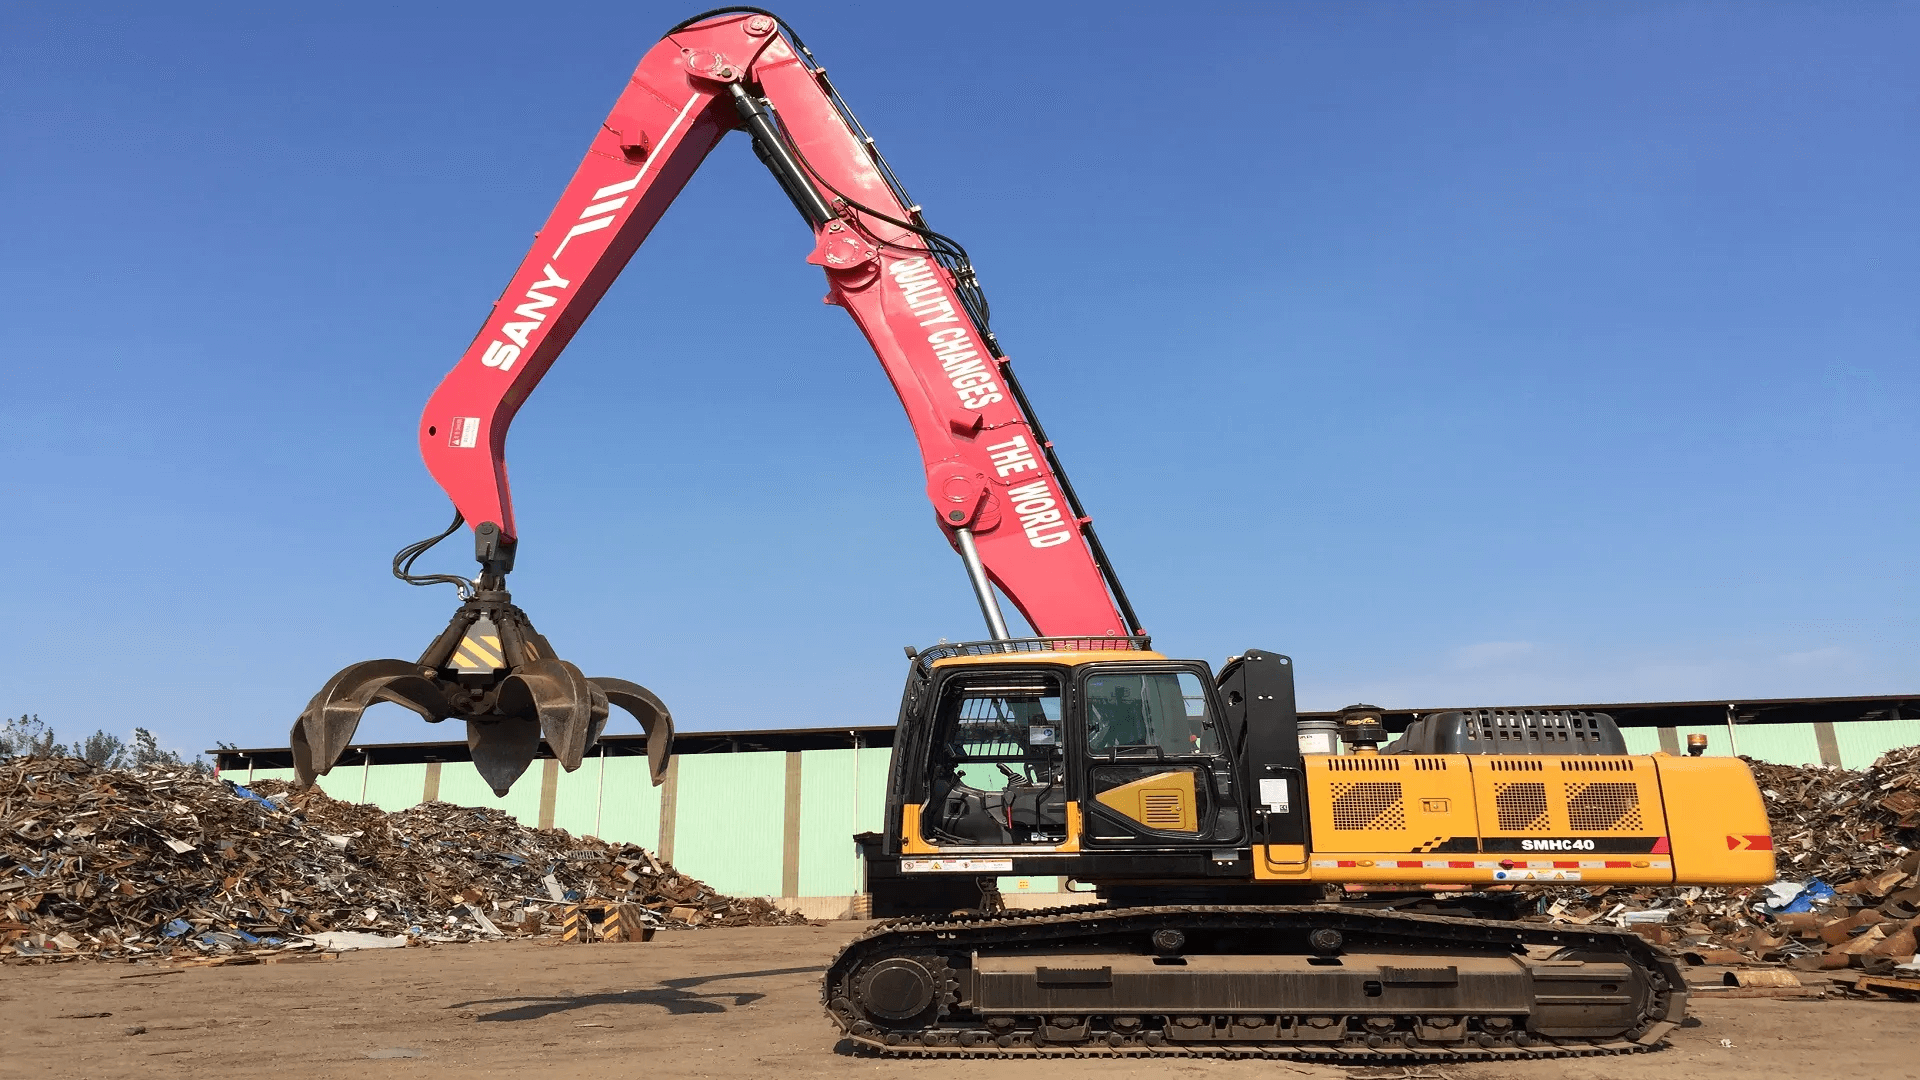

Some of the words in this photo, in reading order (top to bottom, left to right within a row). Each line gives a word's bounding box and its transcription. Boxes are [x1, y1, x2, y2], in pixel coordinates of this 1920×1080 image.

[481, 262, 571, 372] SANY
[887, 255, 960, 327] QUALITY
[926, 326, 1004, 410] CHANGES
[985, 434, 1039, 478] THE
[1006, 480, 1072, 549] WORLD
[1521, 839, 1595, 851] SMHC40
